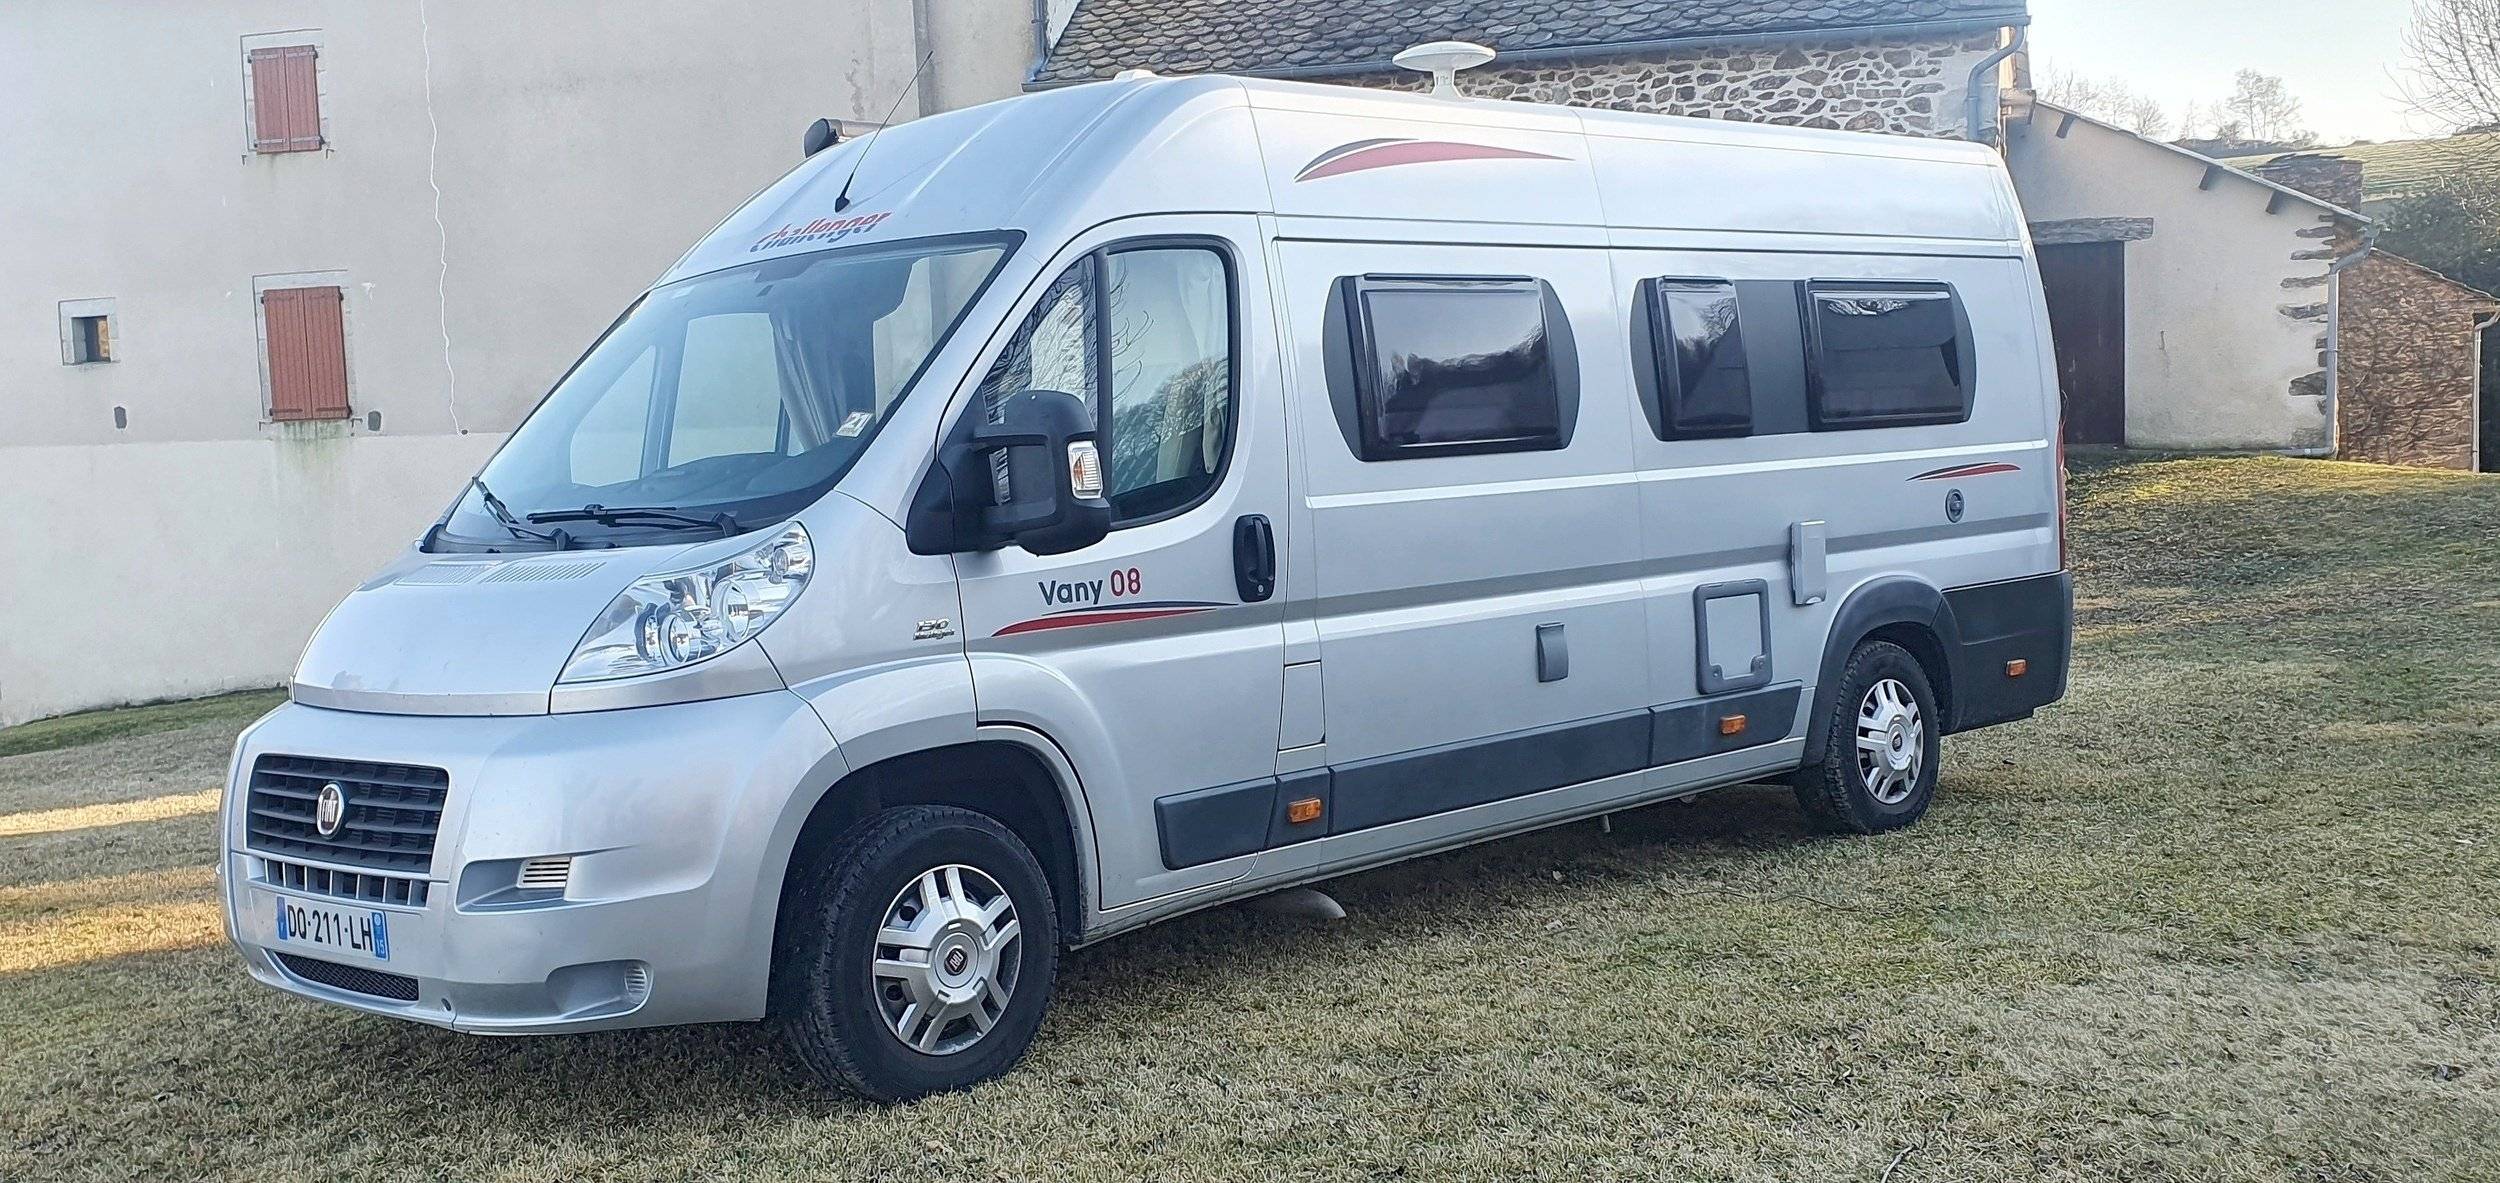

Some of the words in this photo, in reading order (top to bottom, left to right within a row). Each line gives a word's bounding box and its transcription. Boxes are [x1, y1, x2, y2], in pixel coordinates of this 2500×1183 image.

[1038, 580, 1103, 605] Vany
[1111, 568, 1141, 596] 08
[287, 904, 373, 952] DQ-211-LH
[376, 939, 386, 955] 15
